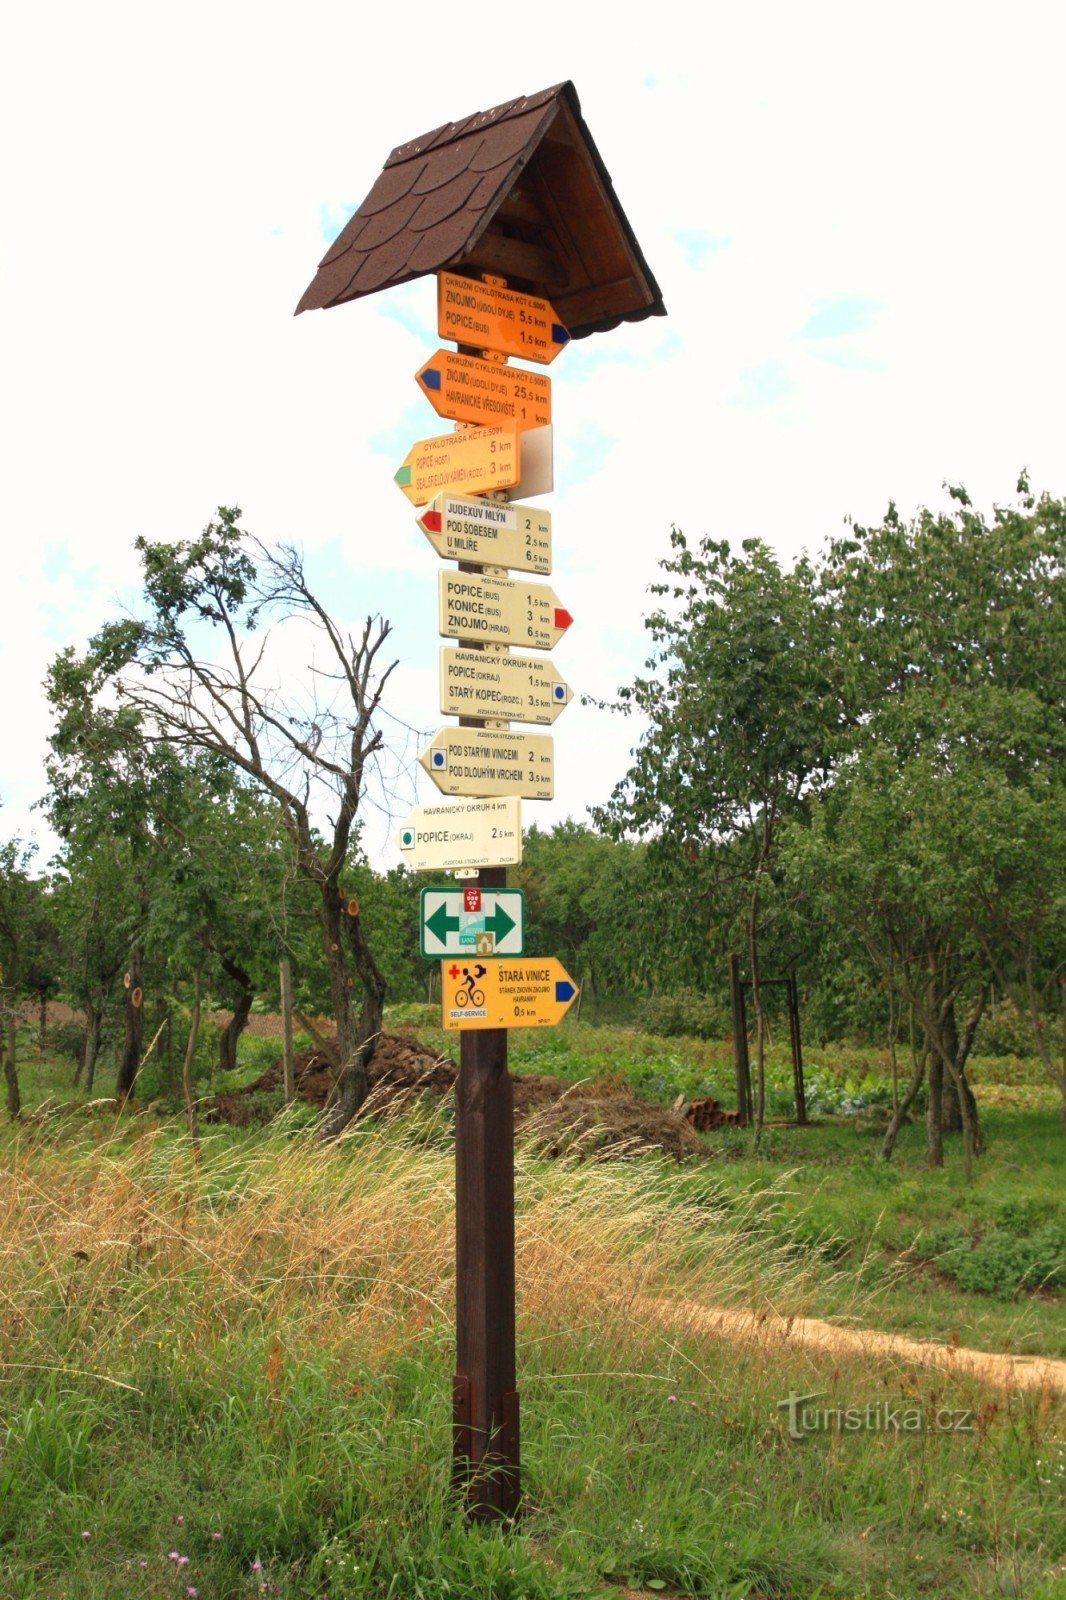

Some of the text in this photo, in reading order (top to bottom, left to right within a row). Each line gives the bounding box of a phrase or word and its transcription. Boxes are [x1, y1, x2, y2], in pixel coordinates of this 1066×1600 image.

[475, 285, 513, 302] CYKLOTRASA
[446, 291, 476, 309] ZNOJMO
[535, 318, 546, 328] km
[446, 312, 472, 329] POPICE
[473, 323, 489, 336] (BUS)
[535, 337, 546, 347] km
[475, 363, 515, 379] CYKLOTRASA
[447, 368, 468, 385] ZNOJMO
[491, 383, 508, 396] DYJE)
[535, 395, 547, 404] km
[521, 408, 526, 419] 1
[535, 414, 547, 424] km
[424, 436, 466, 452] CYKLOTRASA
[469, 431, 481, 443] KČT
[490, 441, 496, 453] 5
[499, 442, 511, 452] km
[490, 462, 496, 474] 3
[499, 463, 511, 472] km
[485, 509, 506, 523] MLÝN
[526, 520, 531, 529] 2
[539, 525, 548, 533] km
[447, 520, 462, 532] POD
[464, 521, 498, 539] ŠOBESEM
[539, 540, 548, 548] km
[447, 537, 452, 547] U
[455, 537, 478, 551] MILÍŘE
[539, 555, 548, 564] km
[448, 583, 482, 598] POPICE
[484, 591, 499, 602] (BUS)
[540, 599, 550, 608] km
[448, 599, 550, 623] KONICE (BUS) 3 km
[448, 615, 488, 630] ZNOJMO
[489, 623, 510, 635] (HRAD)
[540, 631, 550, 639] km
[456, 653, 500, 665] HAVRANICKÝ
[502, 658, 527, 668] OKRUH
[449, 665, 475, 679] POPICE
[476, 672, 500, 684] (OKRAJ)
[541, 680, 550, 688] km
[449, 685, 473, 697] STARÝ
[475, 689, 501, 702] KOPEC
[541, 699, 551, 708] km
[449, 745, 462, 756] POD
[464, 745, 491, 758] STARÝMI
[492, 749, 518, 760] VINICEMI
[529, 752, 534, 762] 2
[449, 766, 462, 777] POD
[465, 765, 496, 780] DLOUHÝM
[496, 769, 523, 781] VRCHEM
[424, 804, 464, 816] HAVRANICKÝ
[467, 804, 490, 813] OKRUH
[417, 831, 449, 843] POPICE
[449, 833, 474, 843] (OKRAJ)
[499, 968, 550, 982] STARÁ VINICE
[450, 1010, 486, 1018] SELF-SERVICE
